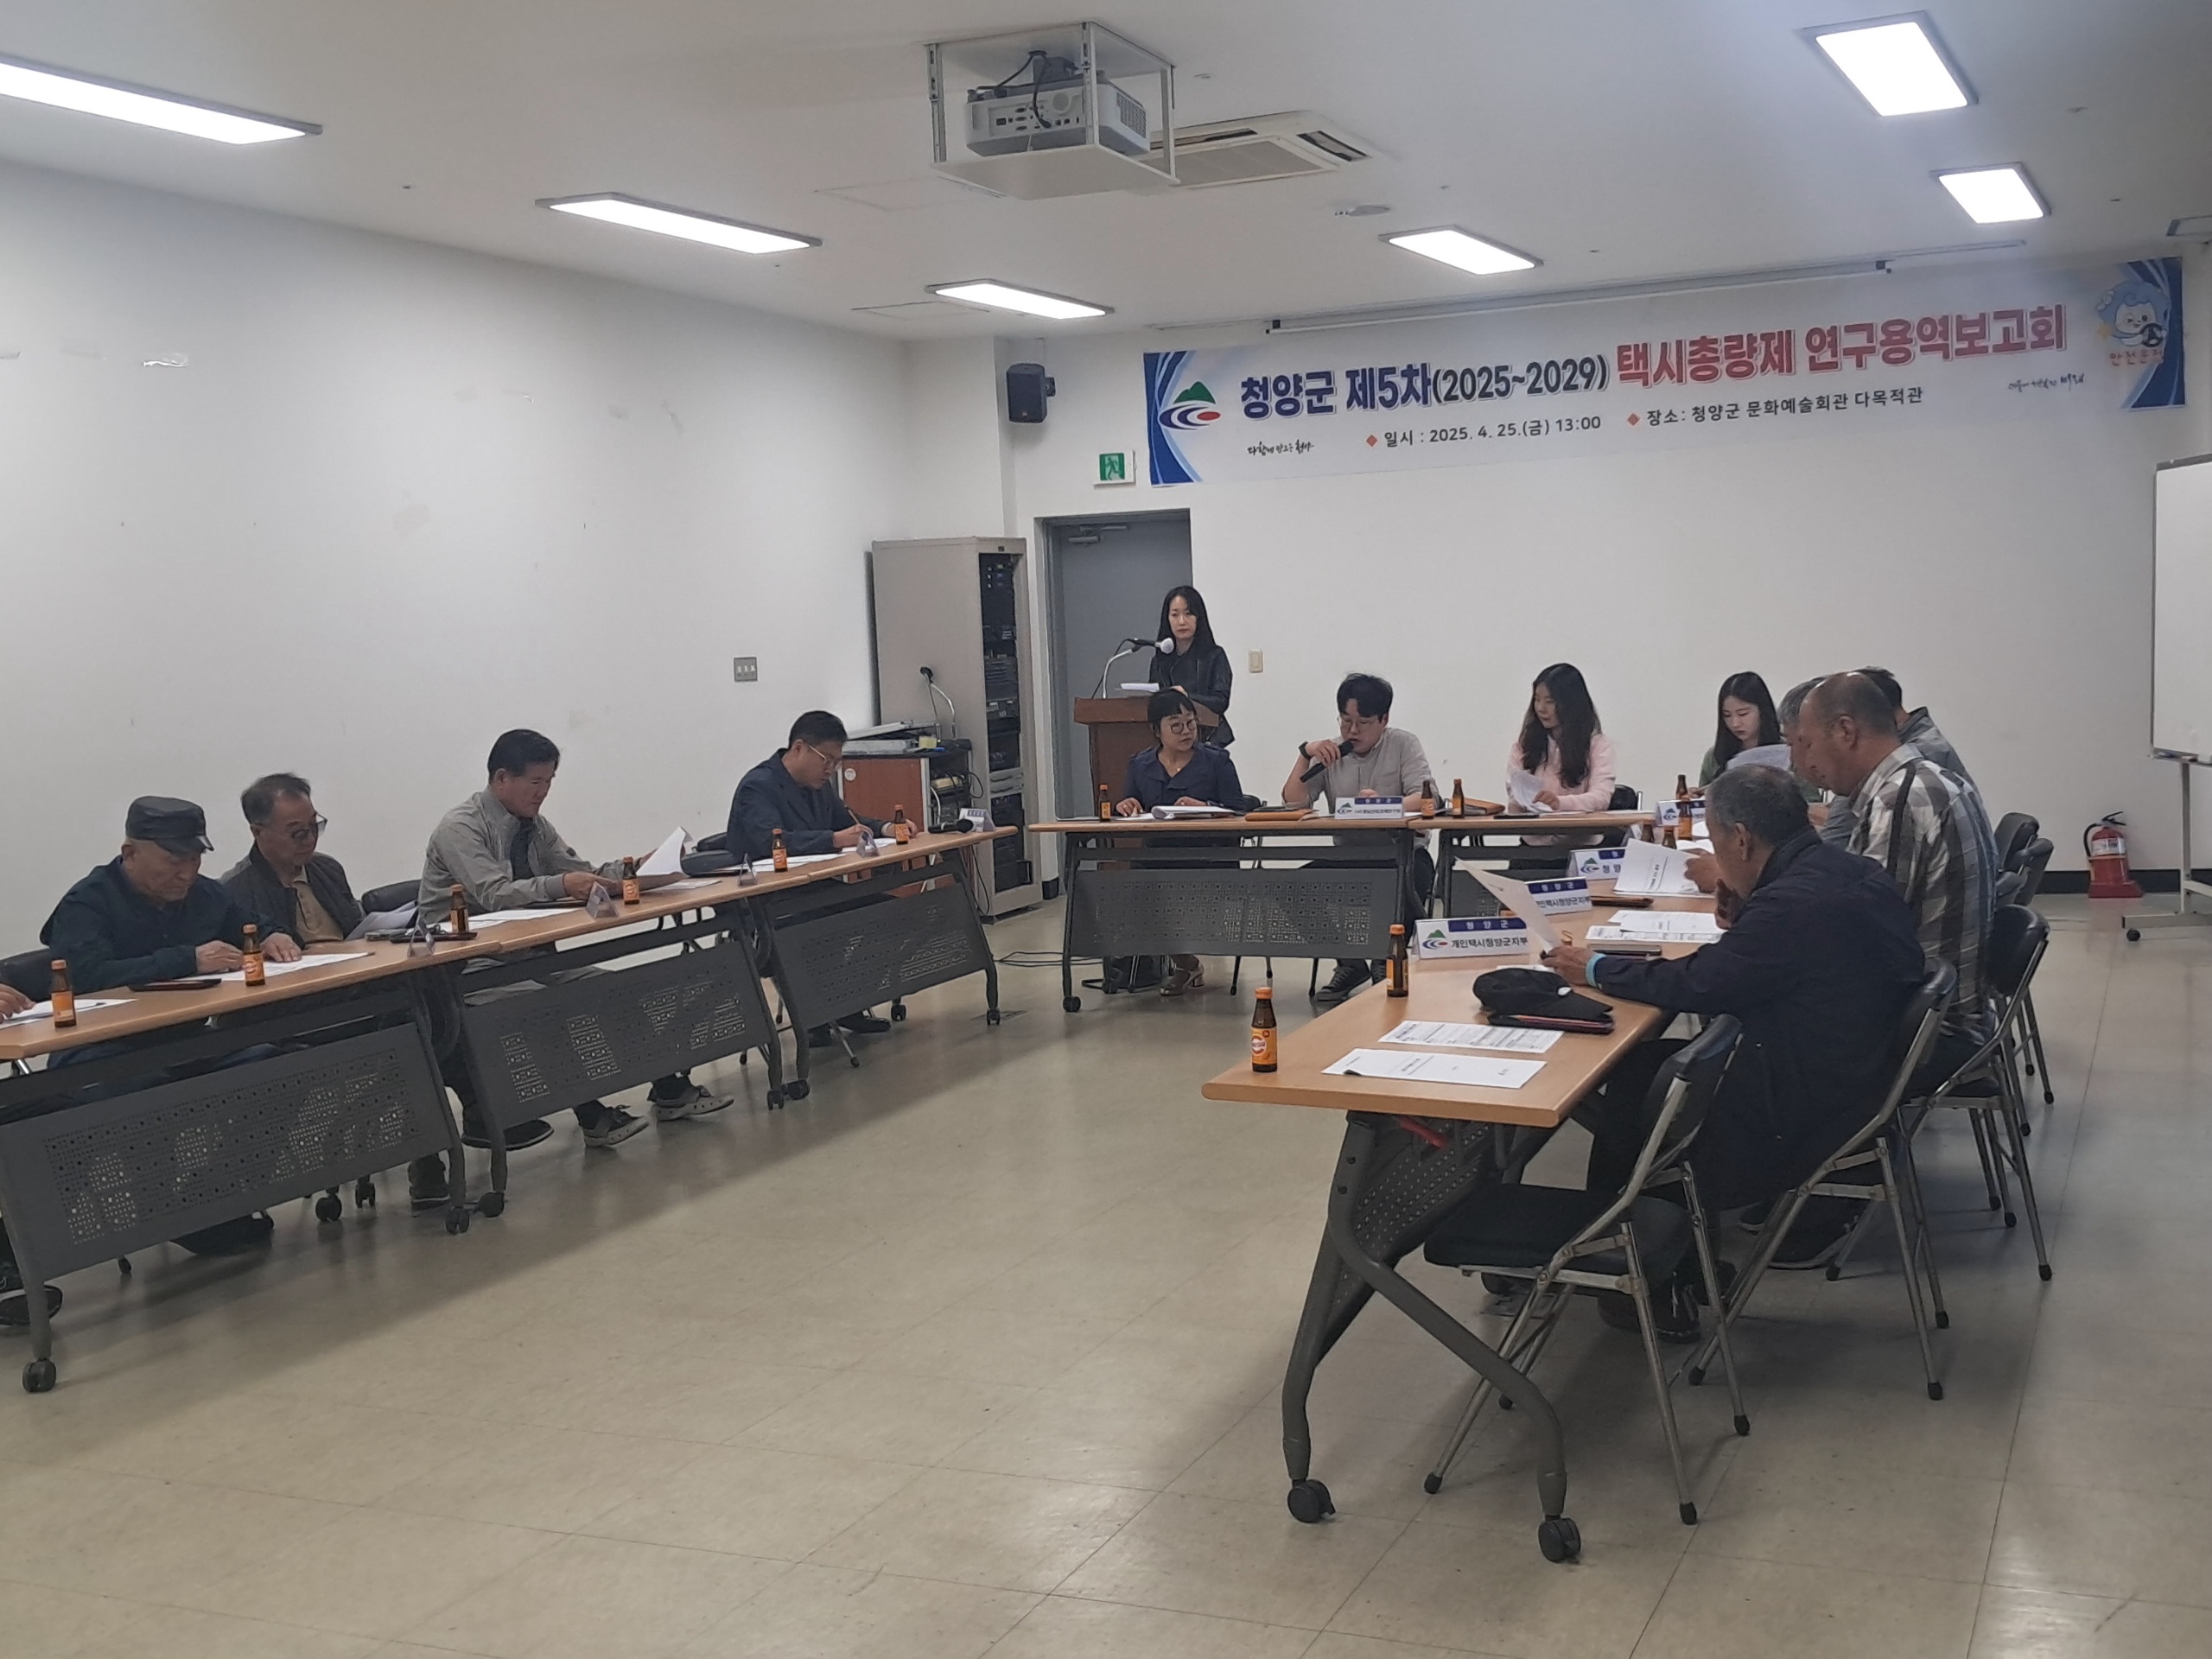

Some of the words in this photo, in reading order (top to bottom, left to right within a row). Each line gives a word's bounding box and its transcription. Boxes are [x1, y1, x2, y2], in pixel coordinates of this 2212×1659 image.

[1241, 371, 1335, 419] 청양군
[1617, 329, 1793, 387] 택시총량제
[1805, 304, 2064, 372] 연구용역보고회
[1692, 403, 1740, 422] 청양군
[1747, 394, 1848, 417] 문화예술회관
[1854, 386, 1923, 408] 다목적관
[1384, 429, 1413, 448] 일시
[1429, 427, 1473, 442] 2025.
[1478, 425, 1493, 439] 4.
[1555, 416, 1601, 433] 13:00
